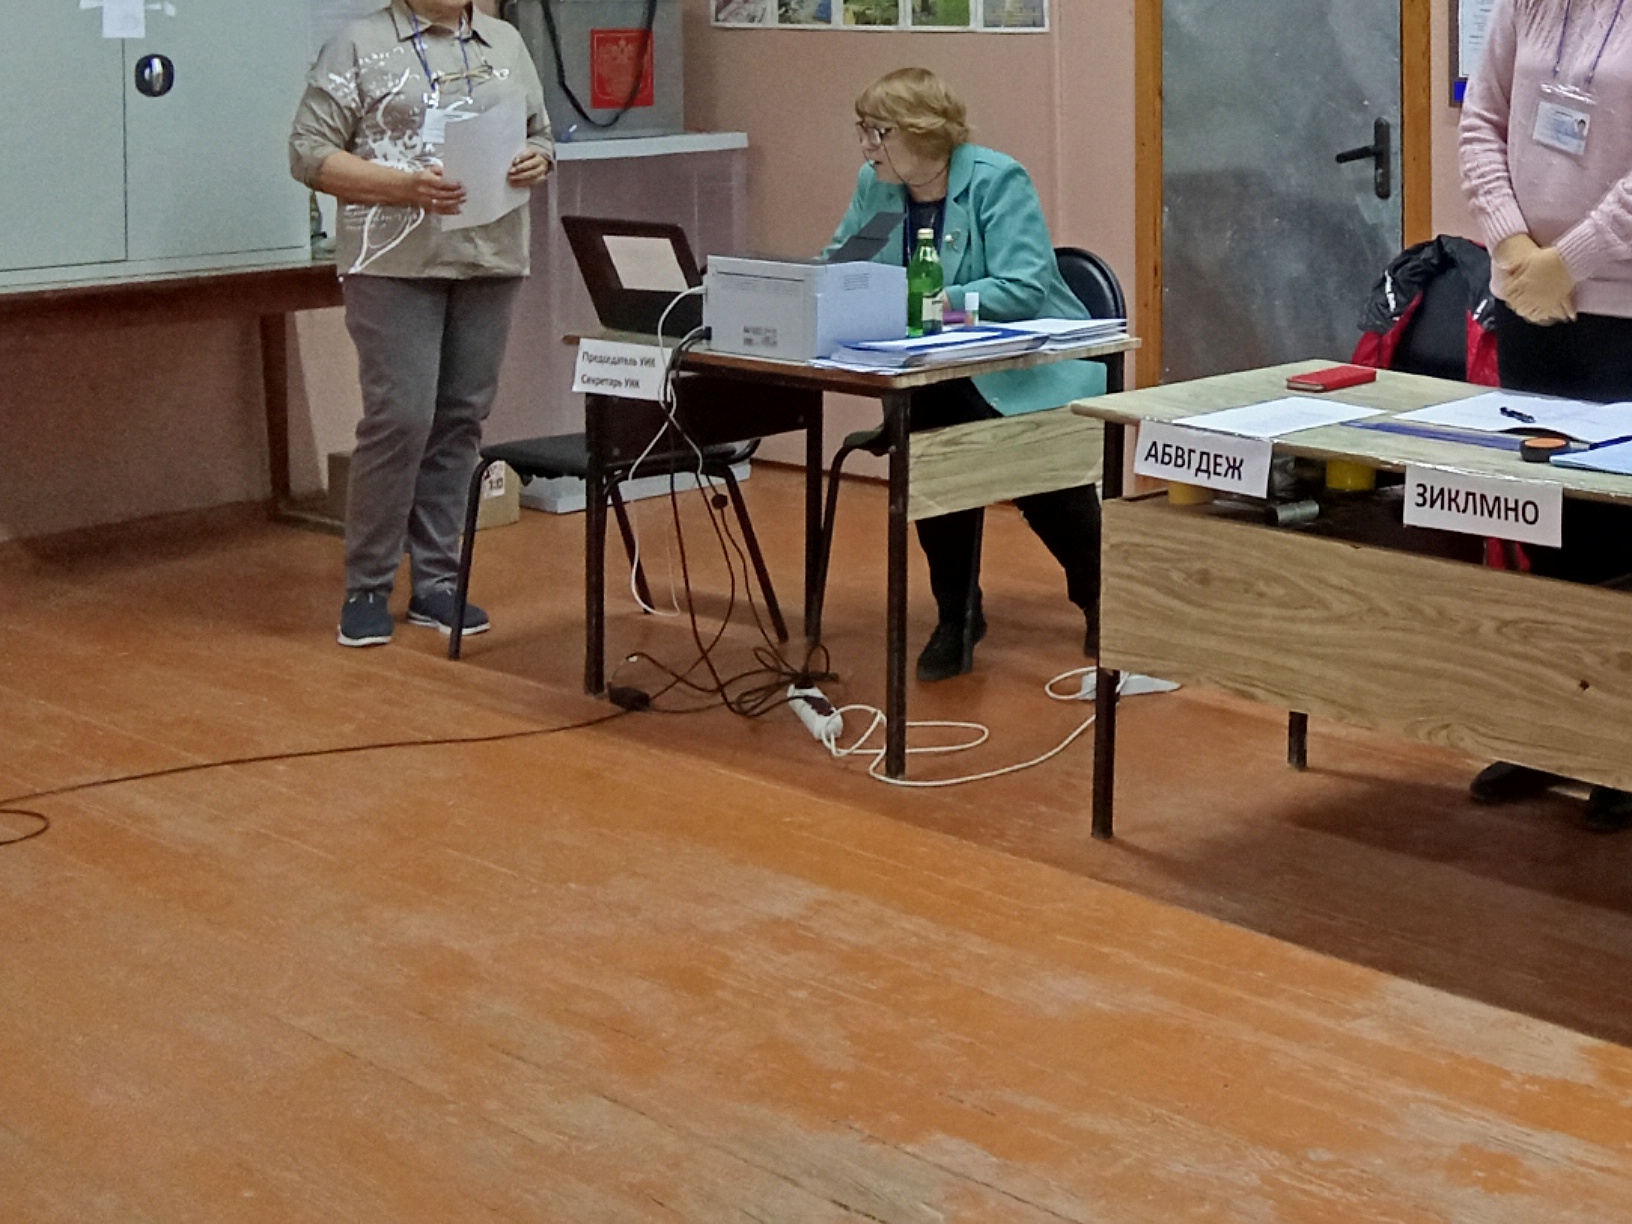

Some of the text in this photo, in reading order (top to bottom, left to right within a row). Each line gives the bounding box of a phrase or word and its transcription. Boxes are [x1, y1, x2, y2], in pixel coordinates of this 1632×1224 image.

[581, 374, 622, 388] Секретарь
[1144, 441, 1244, 480] АБВГДЕЖ
[1415, 483, 1539, 526] ЗИКЛМНО
